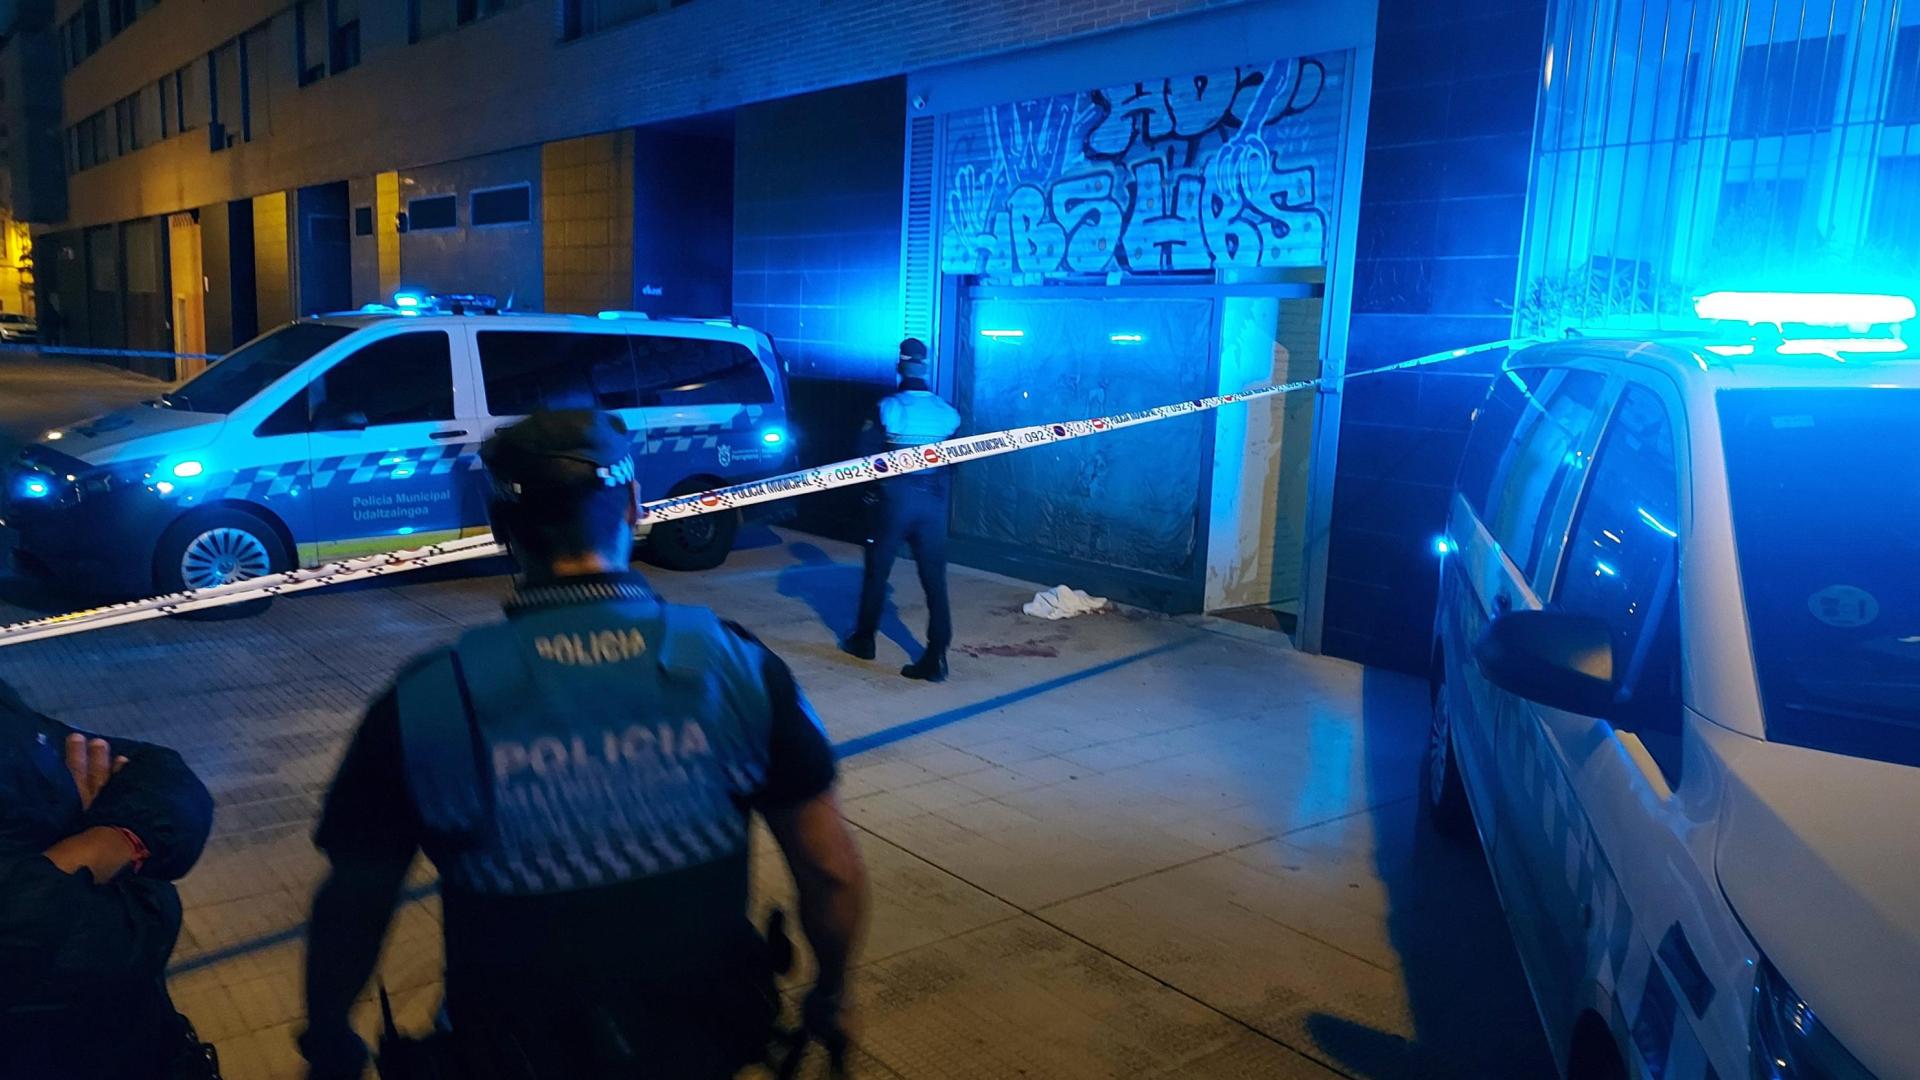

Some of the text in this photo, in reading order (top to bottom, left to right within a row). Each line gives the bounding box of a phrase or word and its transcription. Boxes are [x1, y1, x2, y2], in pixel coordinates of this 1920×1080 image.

[1024, 430, 1045, 444] 092
[835, 465, 863, 481] 092
[396, 489, 450, 503] Municipal
[353, 506, 429, 520] Udaltzaingoa
[493, 718, 710, 778] POLICIA
